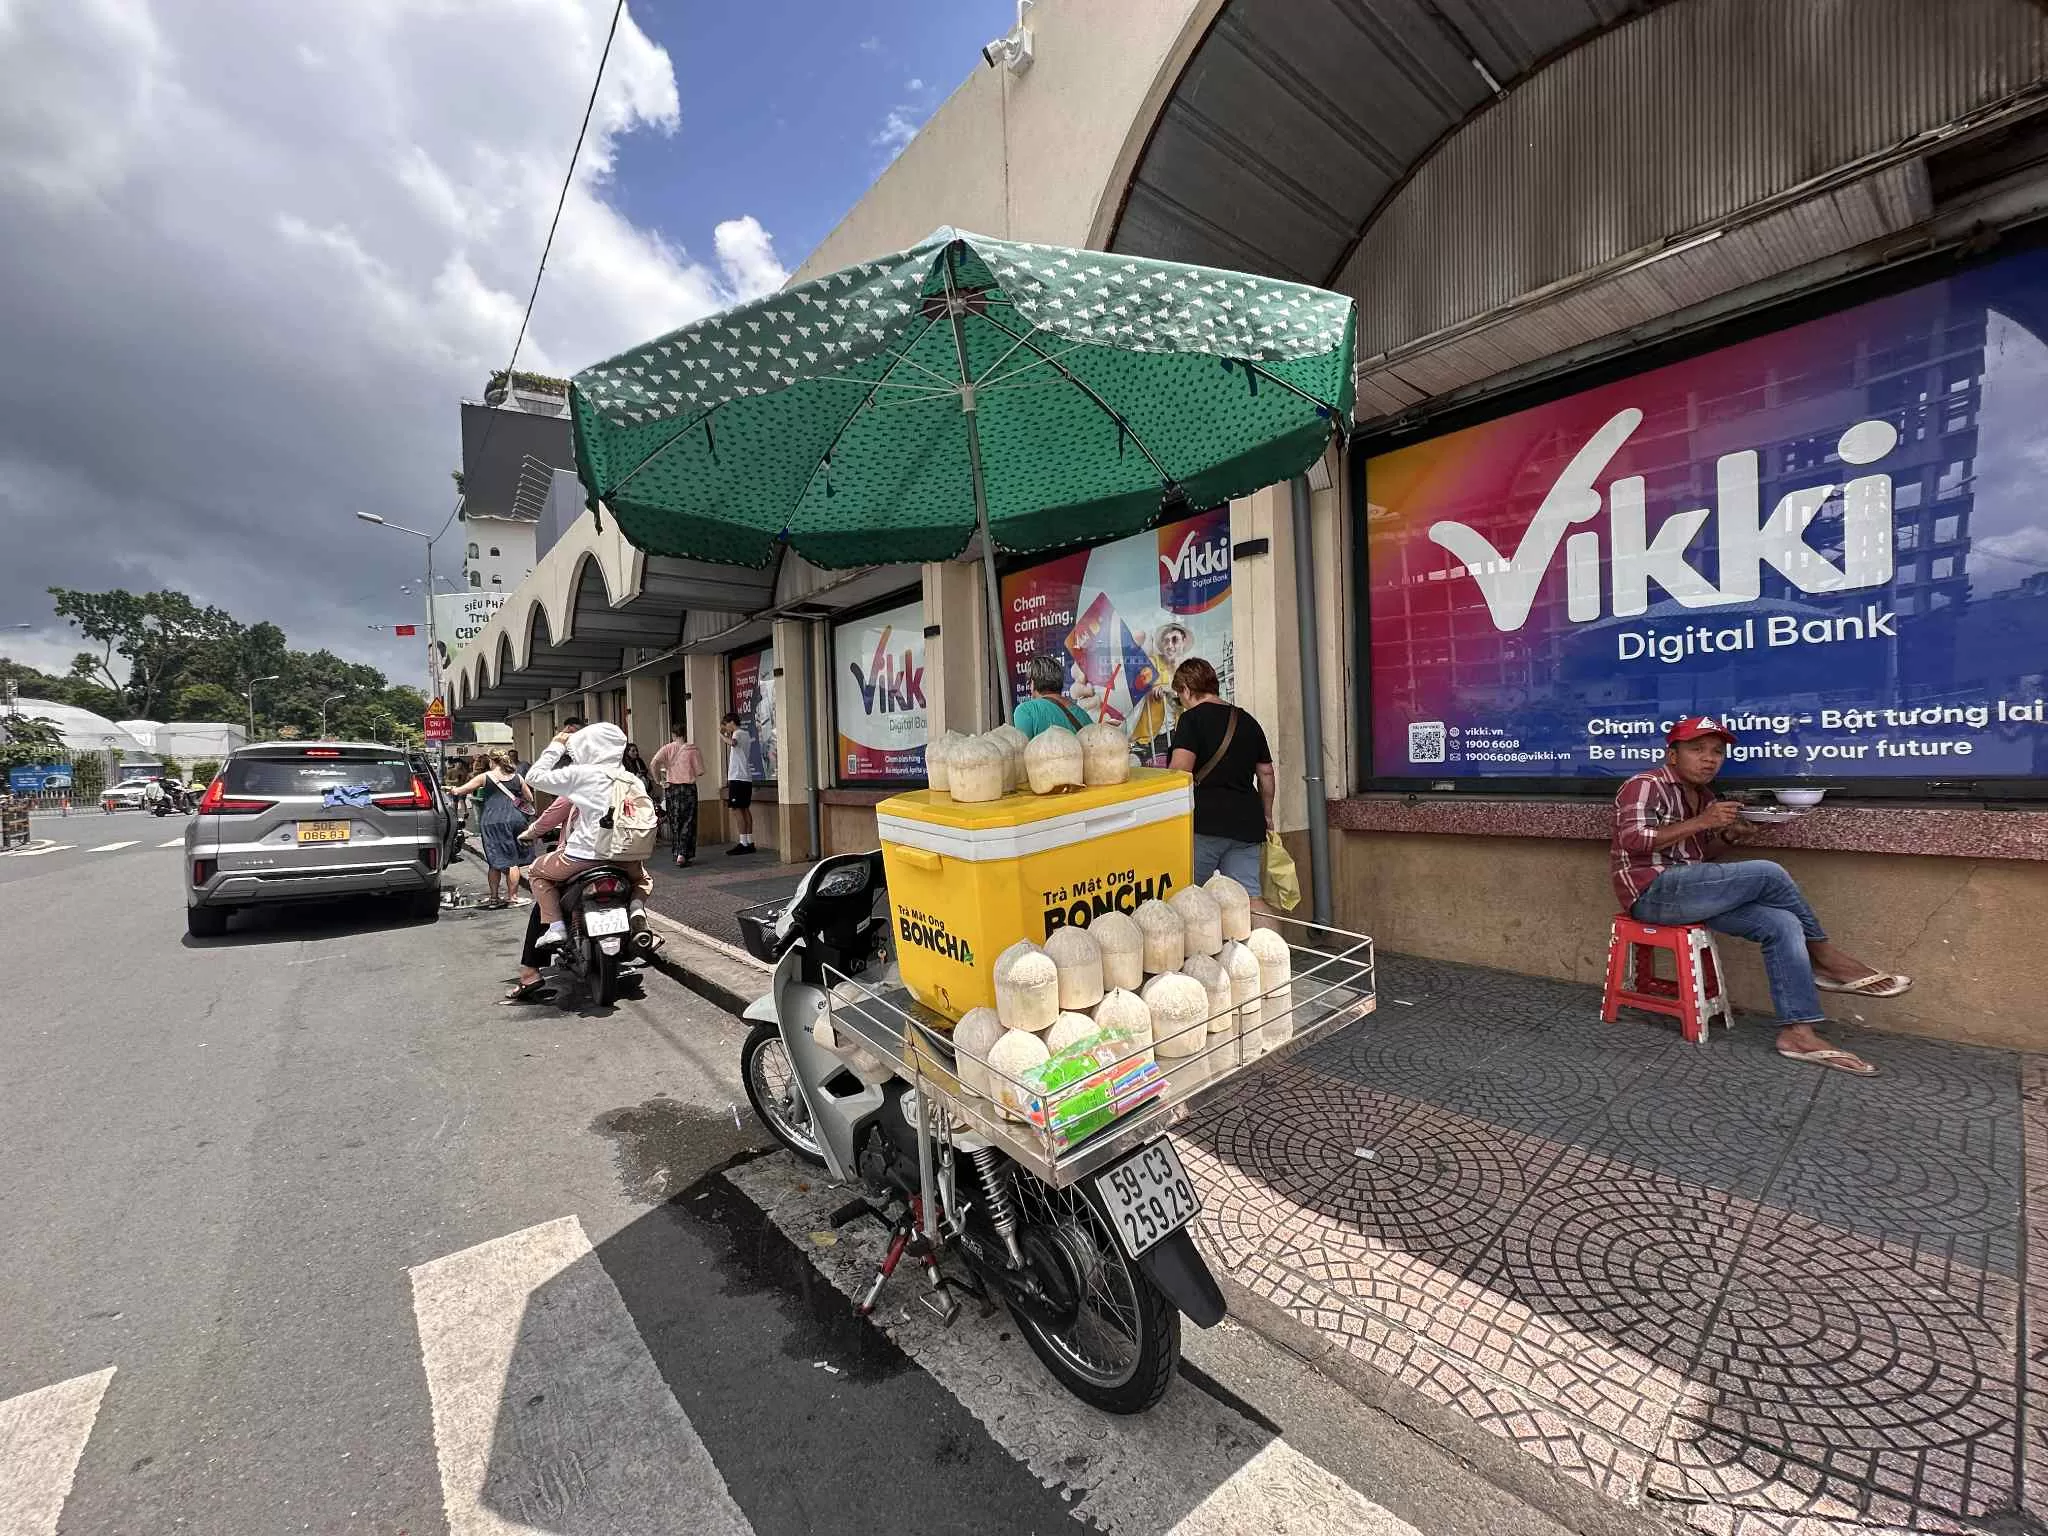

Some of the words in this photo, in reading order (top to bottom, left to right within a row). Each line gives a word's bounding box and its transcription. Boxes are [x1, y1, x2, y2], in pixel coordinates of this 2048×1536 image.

[1429, 407, 1897, 632] Vikki
[1159, 530, 1228, 582] Vikki
[1013, 594, 1046, 613] Chạm
[1014, 615, 1038, 633] cảm
[1040, 610, 1073, 628] hứng,
[1618, 620, 1756, 664] Digital
[1768, 606, 1898, 647] Bank
[1015, 637, 1035, 656] Bật
[889, 717, 913, 734] Digital
[1464, 728, 1504, 737] vikki.vn
[1587, 718, 1655, 739] Chạm
[1721, 712, 1789, 734] hứng
[1821, 708, 1877, 734] Bật
[1885, 704, 1989, 729] tương
[1998, 699, 2044, 722] lai
[1465, 739, 1491, 749] 1900
[1491, 739, 1520, 749] 6608
[1465, 752, 1572, 763] 19006608@vikki.vn
[1589, 745, 1616, 761] Be
[1726, 741, 1798, 762] Ignite
[1806, 745, 1869, 761] your
[1876, 740, 1974, 758] future
[1042, 887, 1068, 905] Trà
[1072, 879, 1102, 897] Mật
[1106, 869, 1135, 886] Ong
[897, 904, 911, 915] Trà
[912, 909, 926, 921] Mật
[928, 914, 945, 932] Ong
[900, 917, 974, 967] BONCHA
[1110, 1147, 1173, 1206] 59-C3
[1124, 1179, 1194, 1250] 259.29
